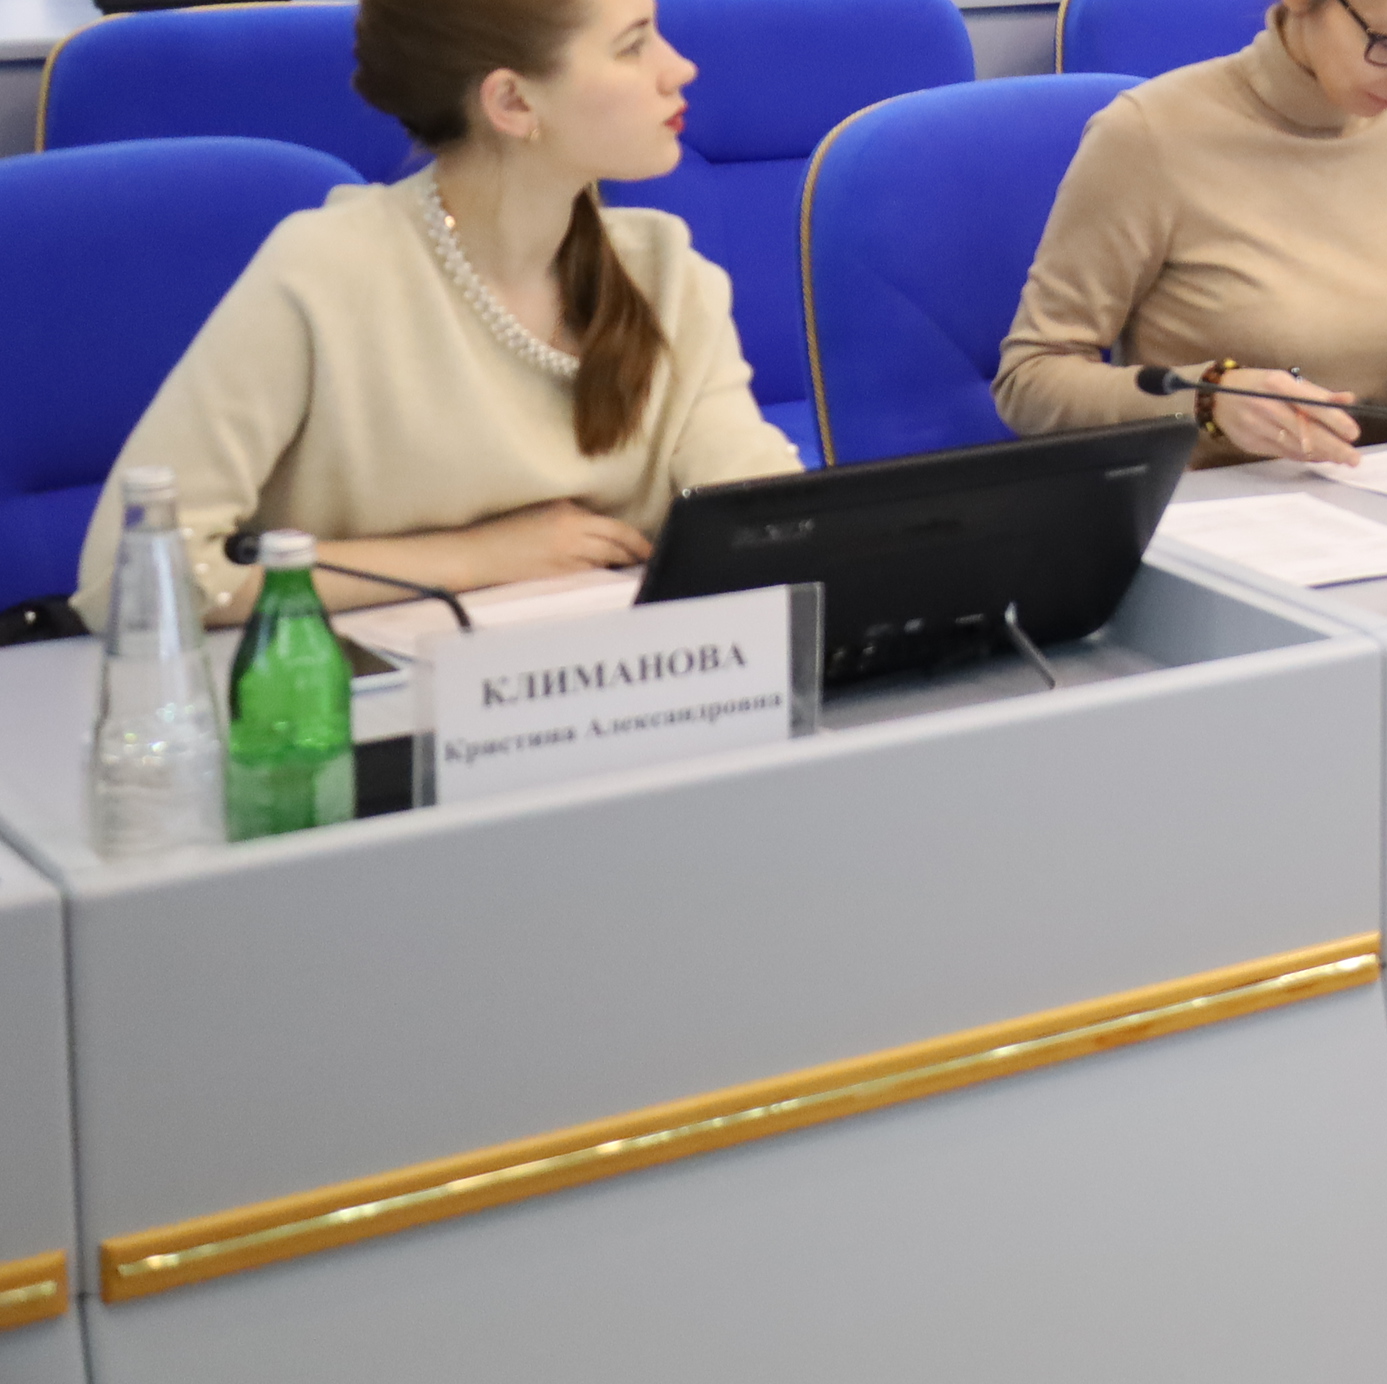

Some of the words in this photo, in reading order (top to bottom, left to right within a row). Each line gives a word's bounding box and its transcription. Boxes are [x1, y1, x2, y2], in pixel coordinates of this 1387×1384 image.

[482, 641, 747, 709] КЛИМАНОВА
[444, 725, 577, 765] Кристина
[585, 691, 783, 739] Александровна
